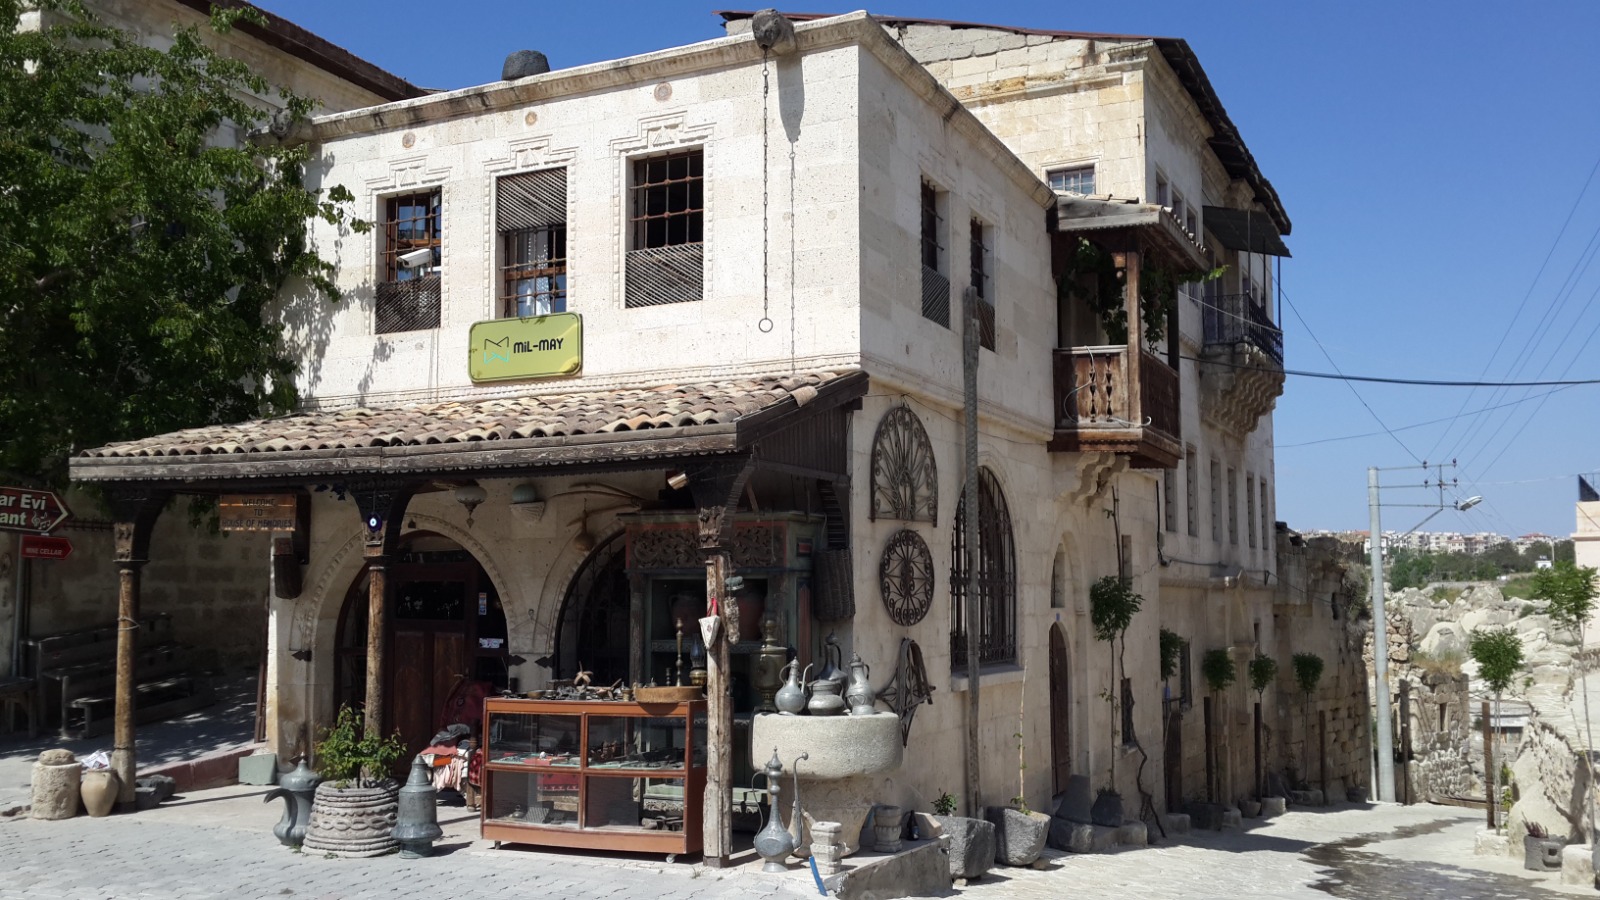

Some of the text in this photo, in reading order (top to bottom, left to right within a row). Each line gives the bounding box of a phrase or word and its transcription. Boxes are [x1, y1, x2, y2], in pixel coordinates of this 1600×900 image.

[20, 494, 46, 510] Evi
[241, 498, 275, 506] WELCOME
[254, 508, 263, 516] TO
[221, 519, 292, 527] HOUSE OF MEMORIES
